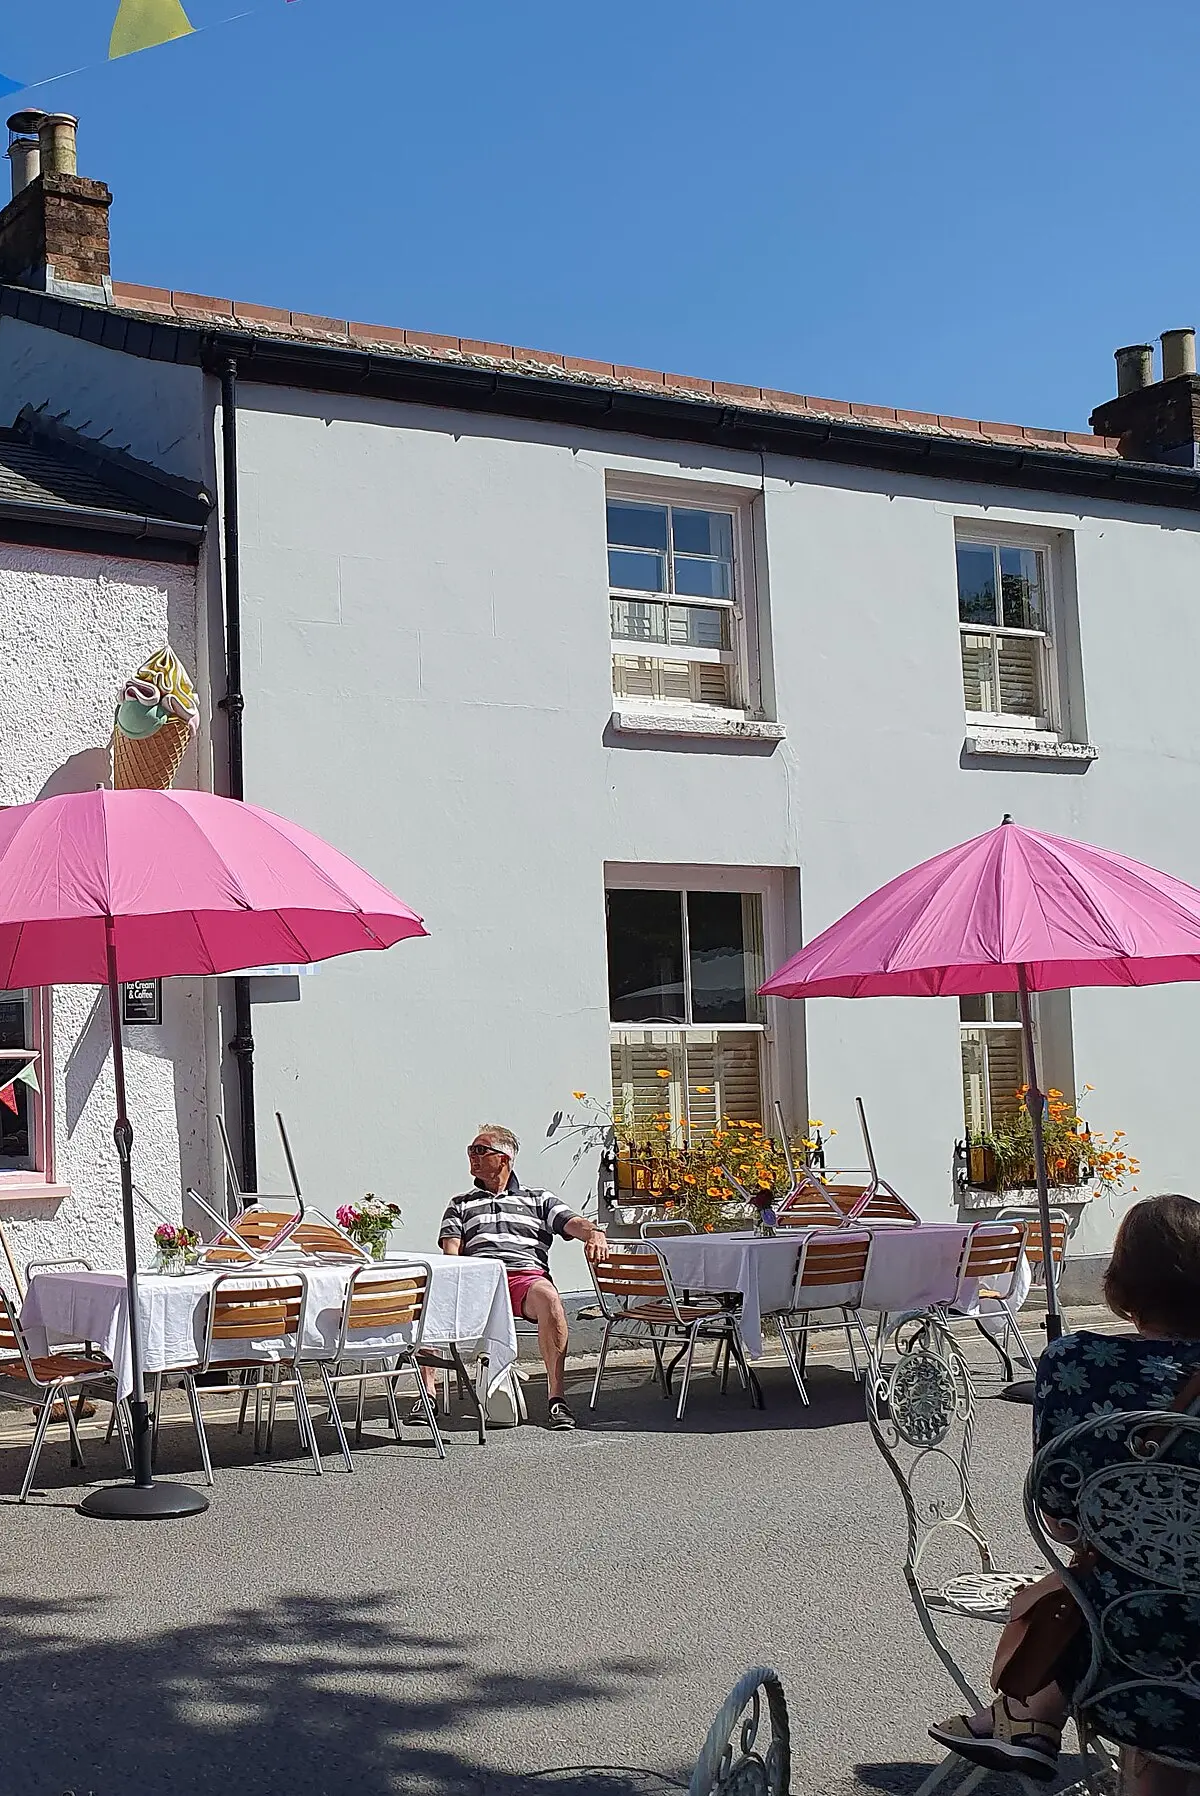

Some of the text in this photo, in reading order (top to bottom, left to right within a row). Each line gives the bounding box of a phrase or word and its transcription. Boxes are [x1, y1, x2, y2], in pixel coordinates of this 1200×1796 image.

[126, 981, 154, 990] Ice Cream
[128, 989, 153, 999] & Coffee
